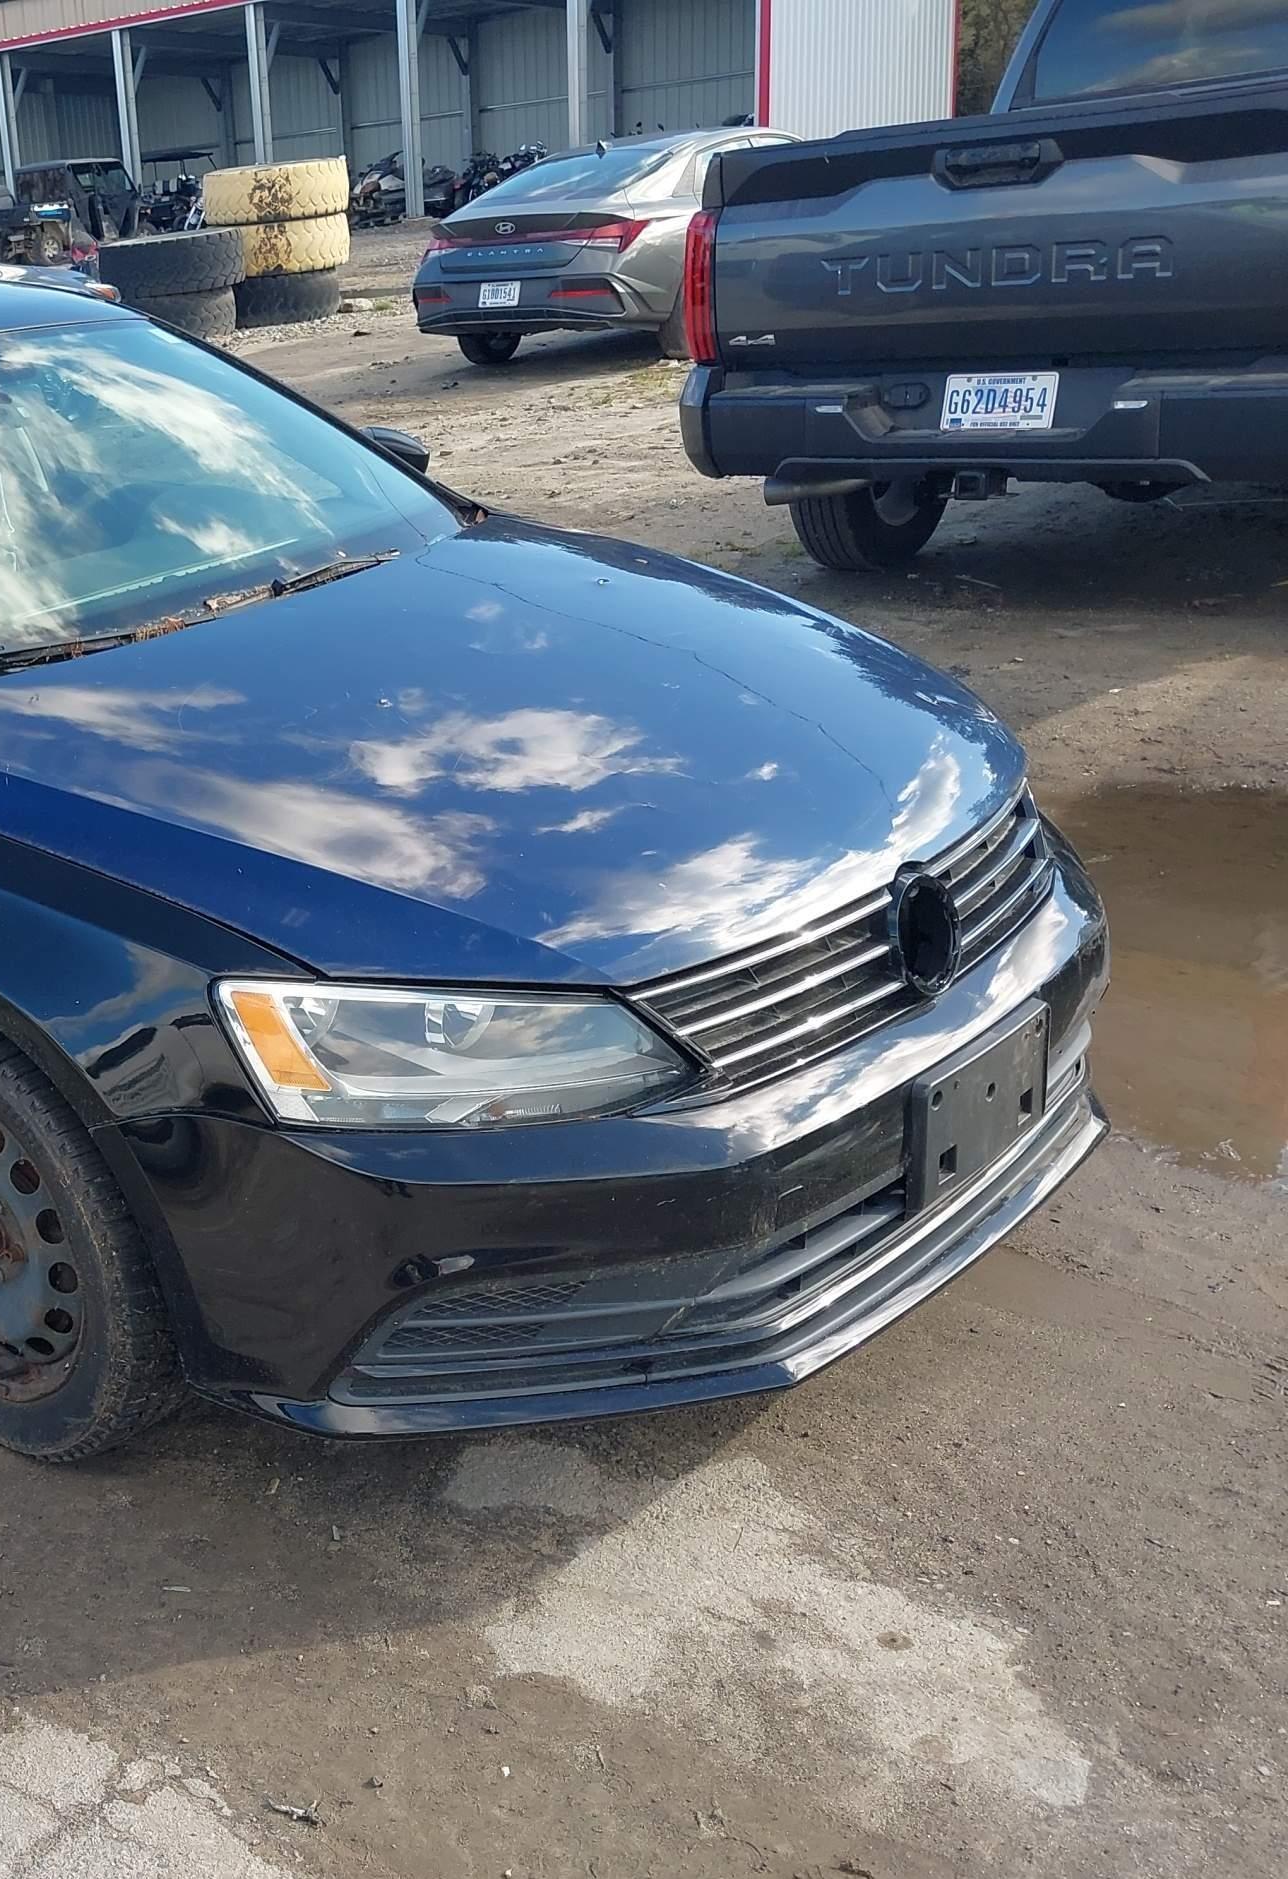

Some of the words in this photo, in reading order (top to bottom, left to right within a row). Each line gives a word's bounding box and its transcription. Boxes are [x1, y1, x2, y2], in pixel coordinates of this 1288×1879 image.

[466, 247, 544, 257] ELANTRA
[820, 234, 1175, 297] TUNDRA
[948, 387, 1048, 415] G62D4954
